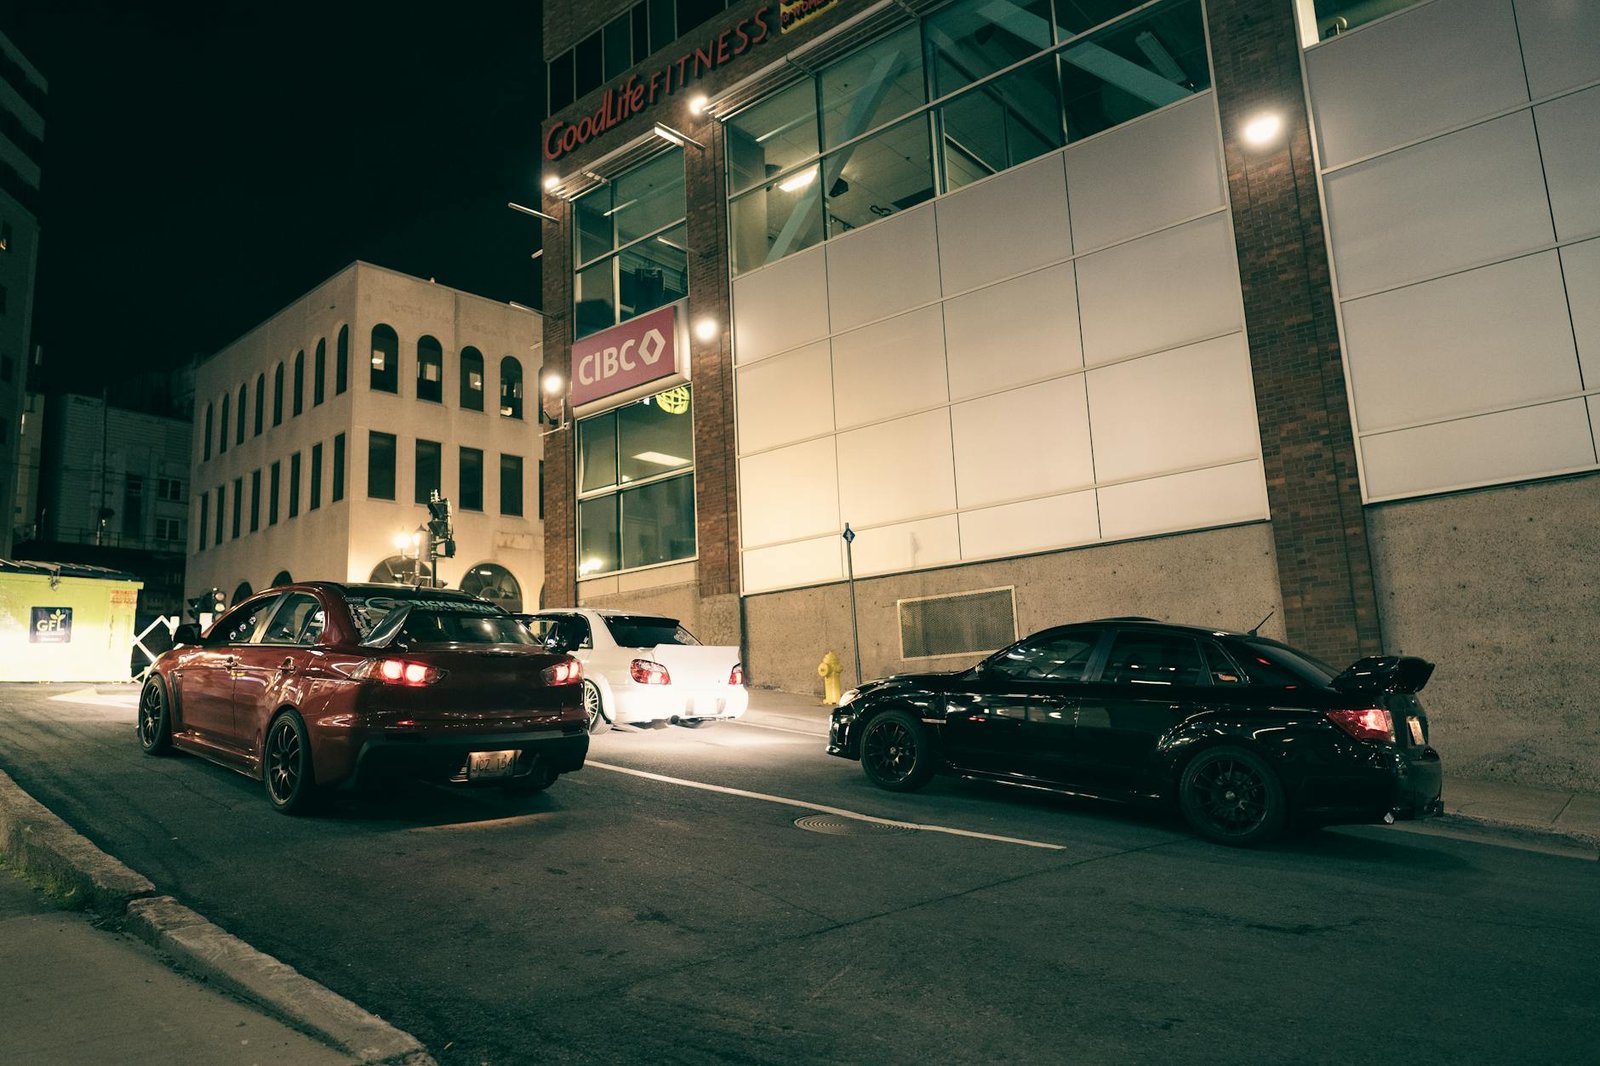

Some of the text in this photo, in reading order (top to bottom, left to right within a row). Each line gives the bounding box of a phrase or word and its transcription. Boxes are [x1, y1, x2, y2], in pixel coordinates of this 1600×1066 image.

[544, 6, 769, 160] GoodLife FITNESS
[578, 338, 636, 386] CIBC
[36, 619, 65, 632] GFL
